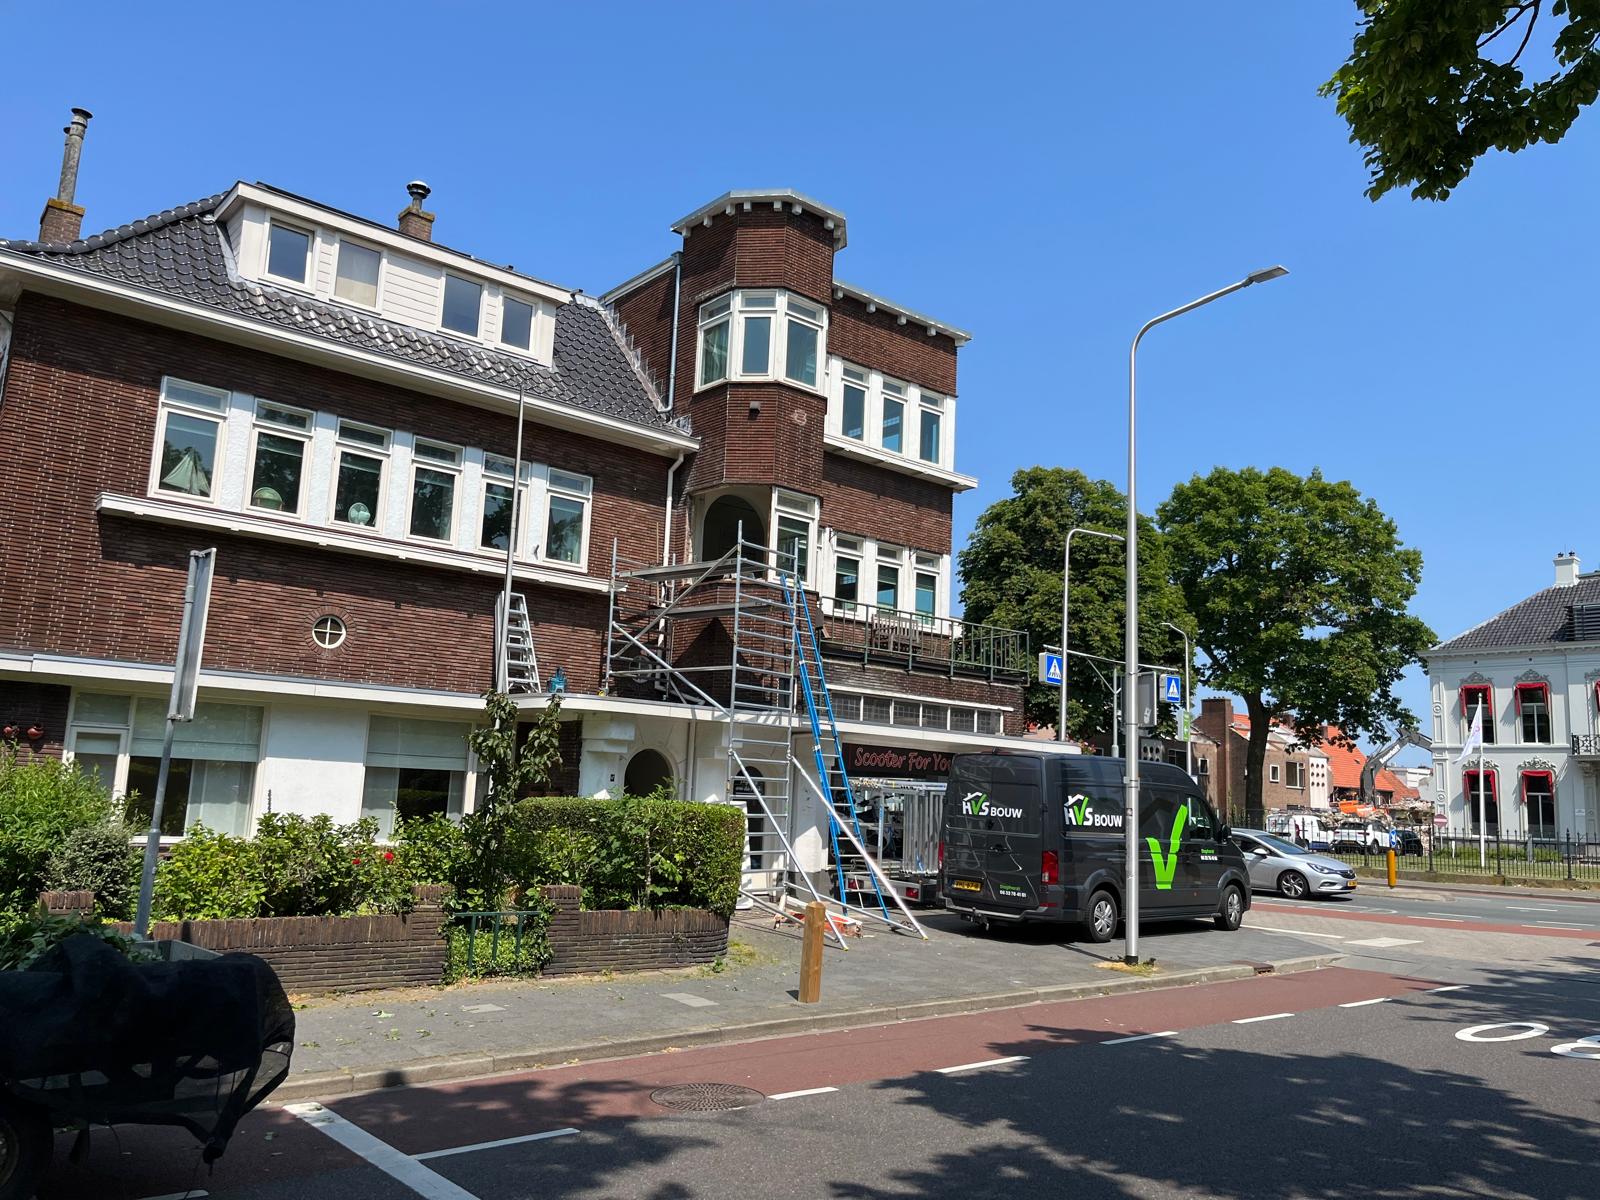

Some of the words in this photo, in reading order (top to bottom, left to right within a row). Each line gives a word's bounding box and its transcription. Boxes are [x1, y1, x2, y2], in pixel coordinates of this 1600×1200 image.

[854, 747, 906, 769] Scooter
[908, 751, 931, 772] For
[962, 793, 990, 816] HVS
[990, 806, 1023, 819] BOUW
[1064, 796, 1094, 826] HVS
[1094, 814, 1123, 828] BOUW
